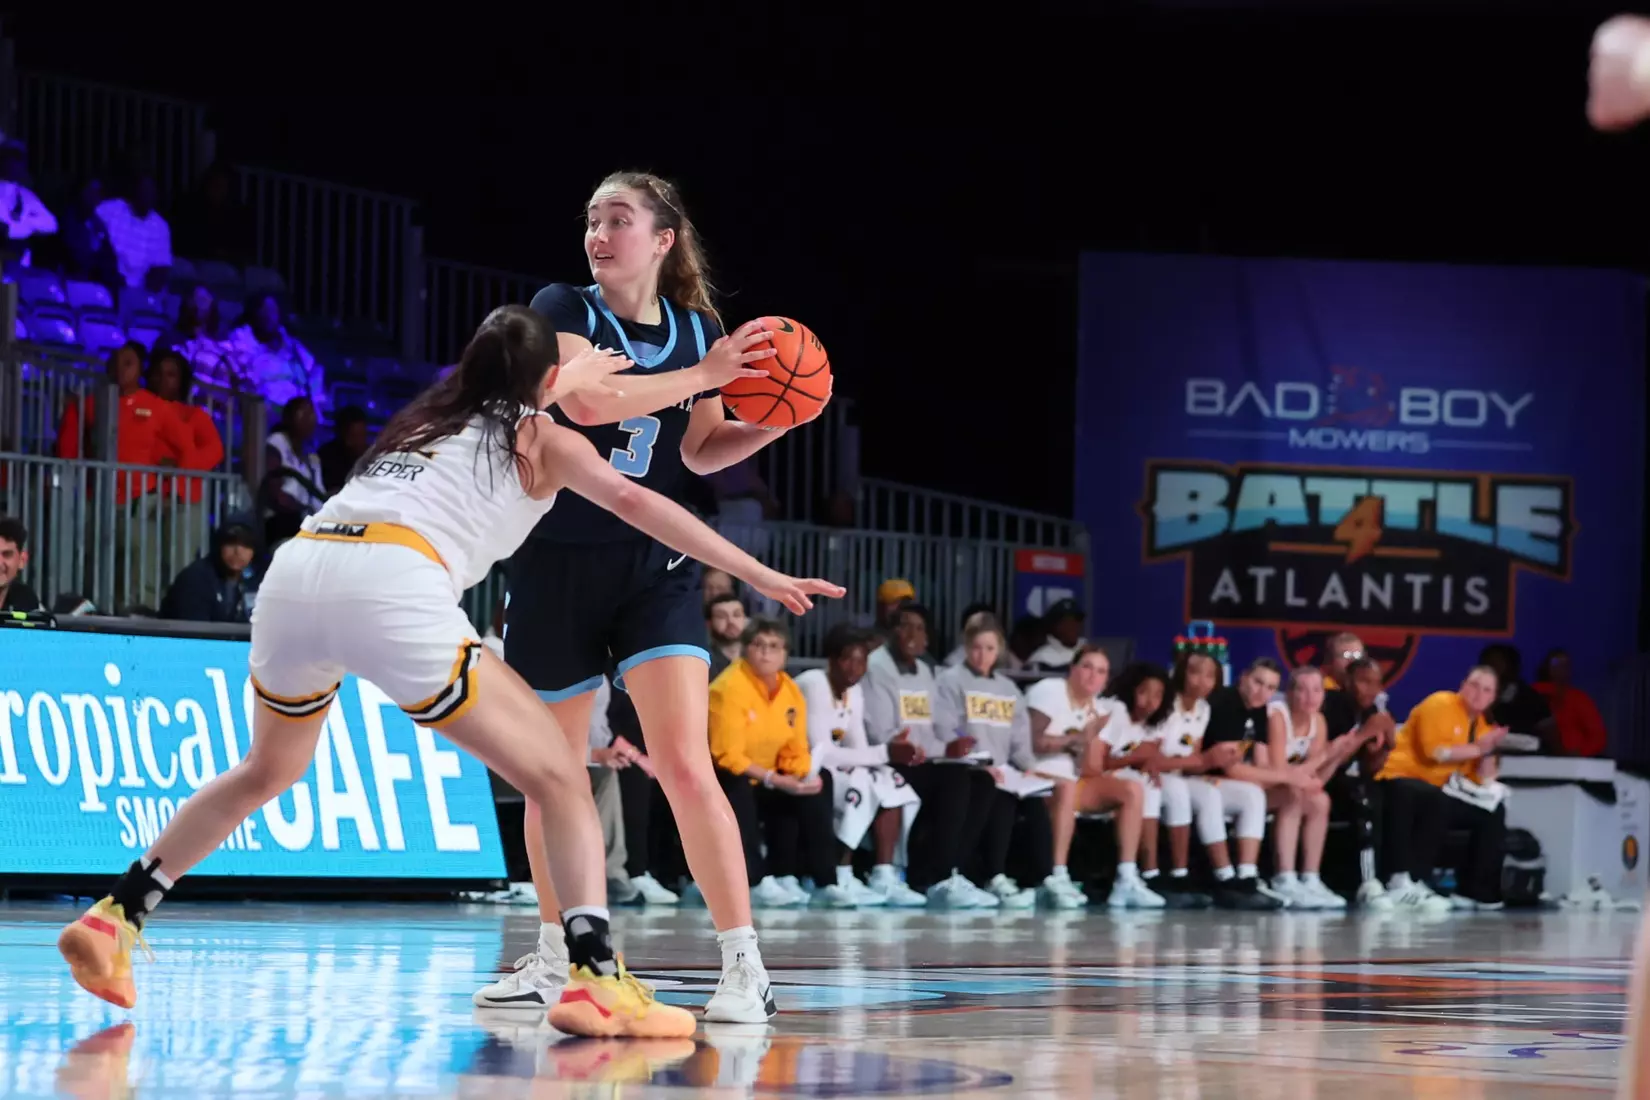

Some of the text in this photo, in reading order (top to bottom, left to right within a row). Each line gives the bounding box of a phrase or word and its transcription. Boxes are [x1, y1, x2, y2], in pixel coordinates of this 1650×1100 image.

[1186, 379, 1534, 428] BAD BOY
[609, 414, 661, 478] 3
[1288, 428, 1431, 454] MOWERS
[1153, 470, 1563, 566] BATTLE
[1334, 495, 1381, 565] 4
[1210, 567, 1490, 614] ATLANTIS
